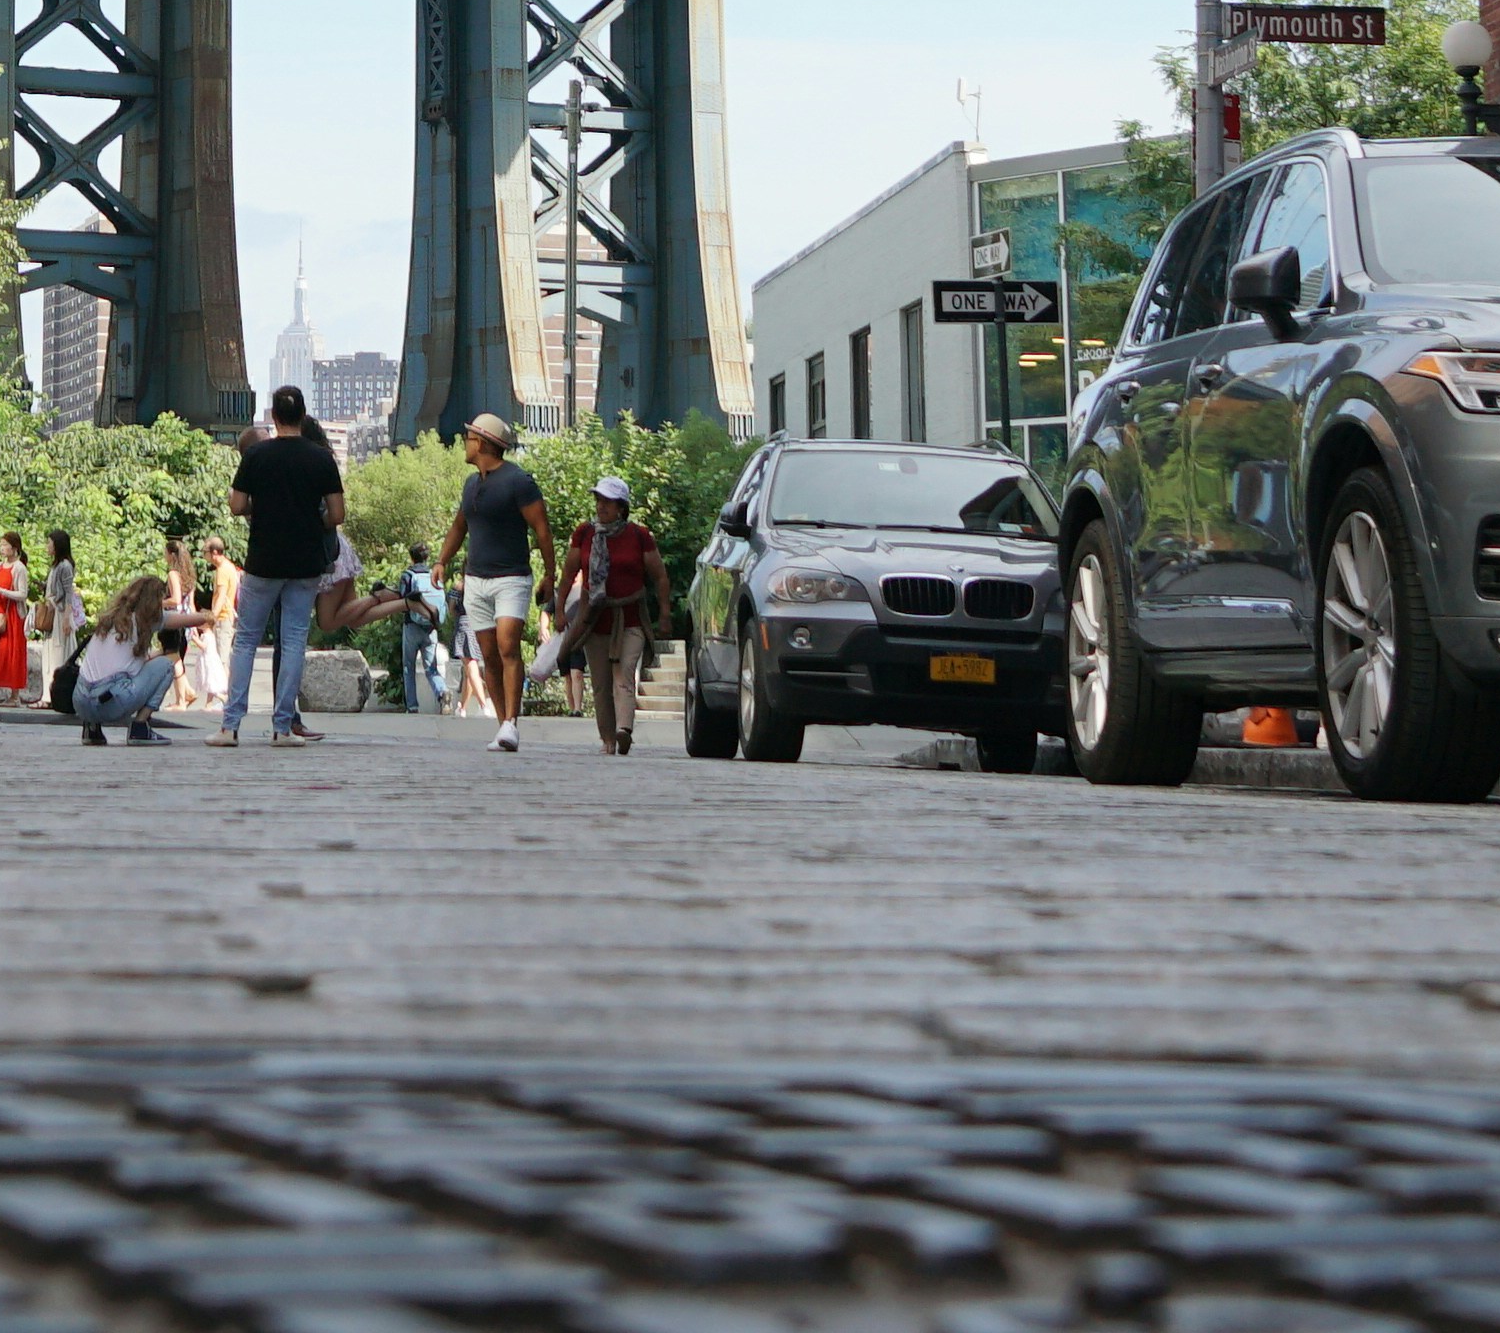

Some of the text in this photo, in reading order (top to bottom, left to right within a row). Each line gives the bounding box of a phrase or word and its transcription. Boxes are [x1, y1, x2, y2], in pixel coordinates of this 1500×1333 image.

[1232, 10, 1374, 41] Plymouth St
[975, 248, 989, 266] ONE
[951, 293, 1040, 310] ONE WAY
